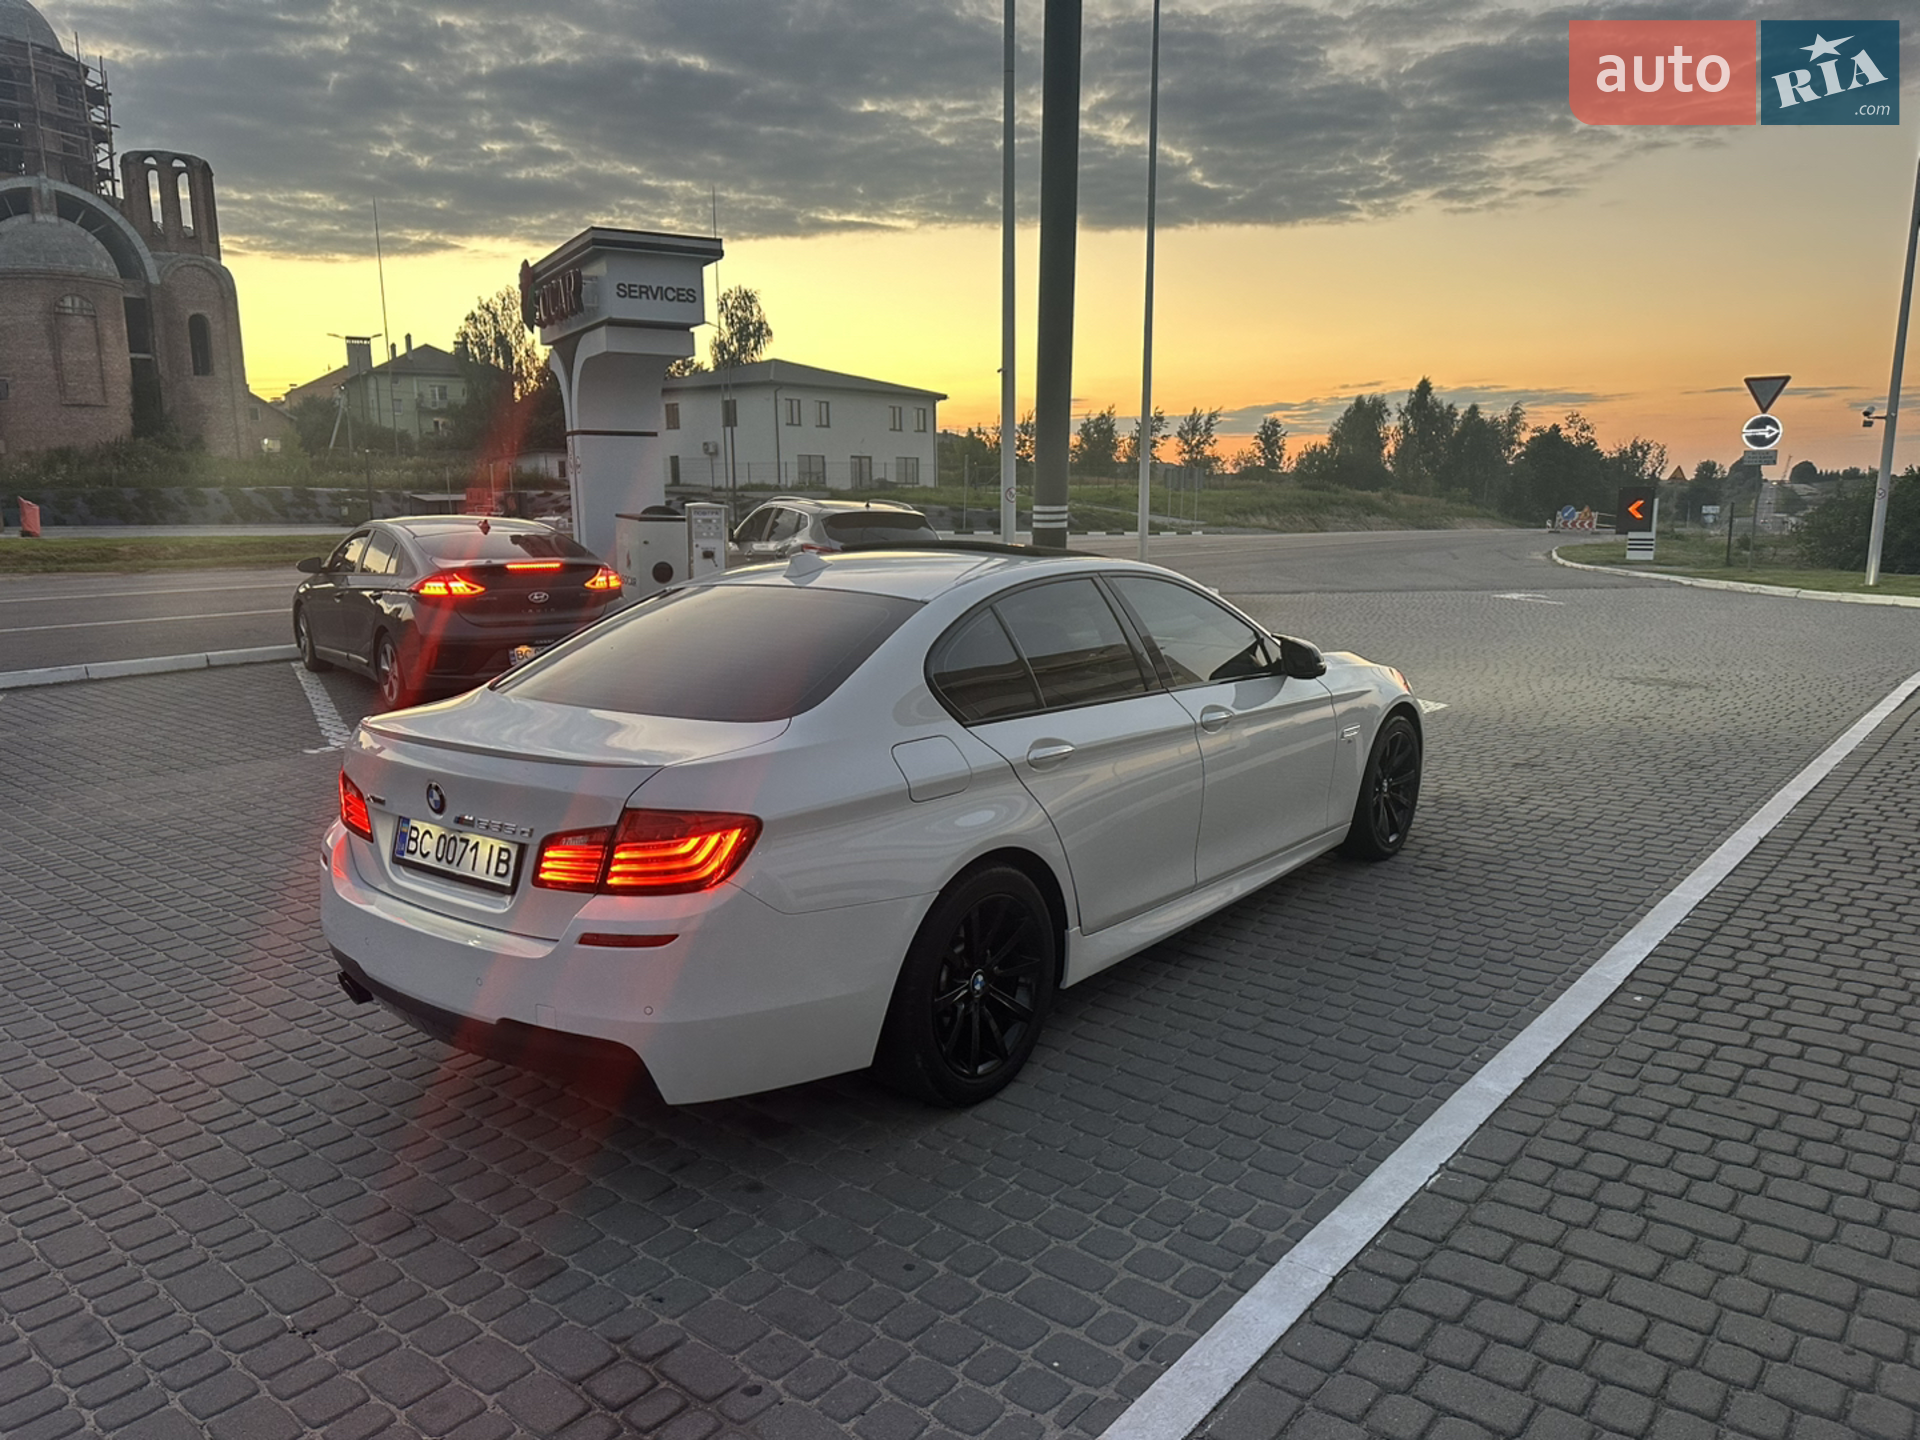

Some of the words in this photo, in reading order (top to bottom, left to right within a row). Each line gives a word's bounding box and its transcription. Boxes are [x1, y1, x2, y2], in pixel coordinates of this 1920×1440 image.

[616, 282, 697, 304] SERVICES
[406, 825, 433, 859] BC
[435, 832, 481, 872] 0071
[485, 843, 512, 878] IB
